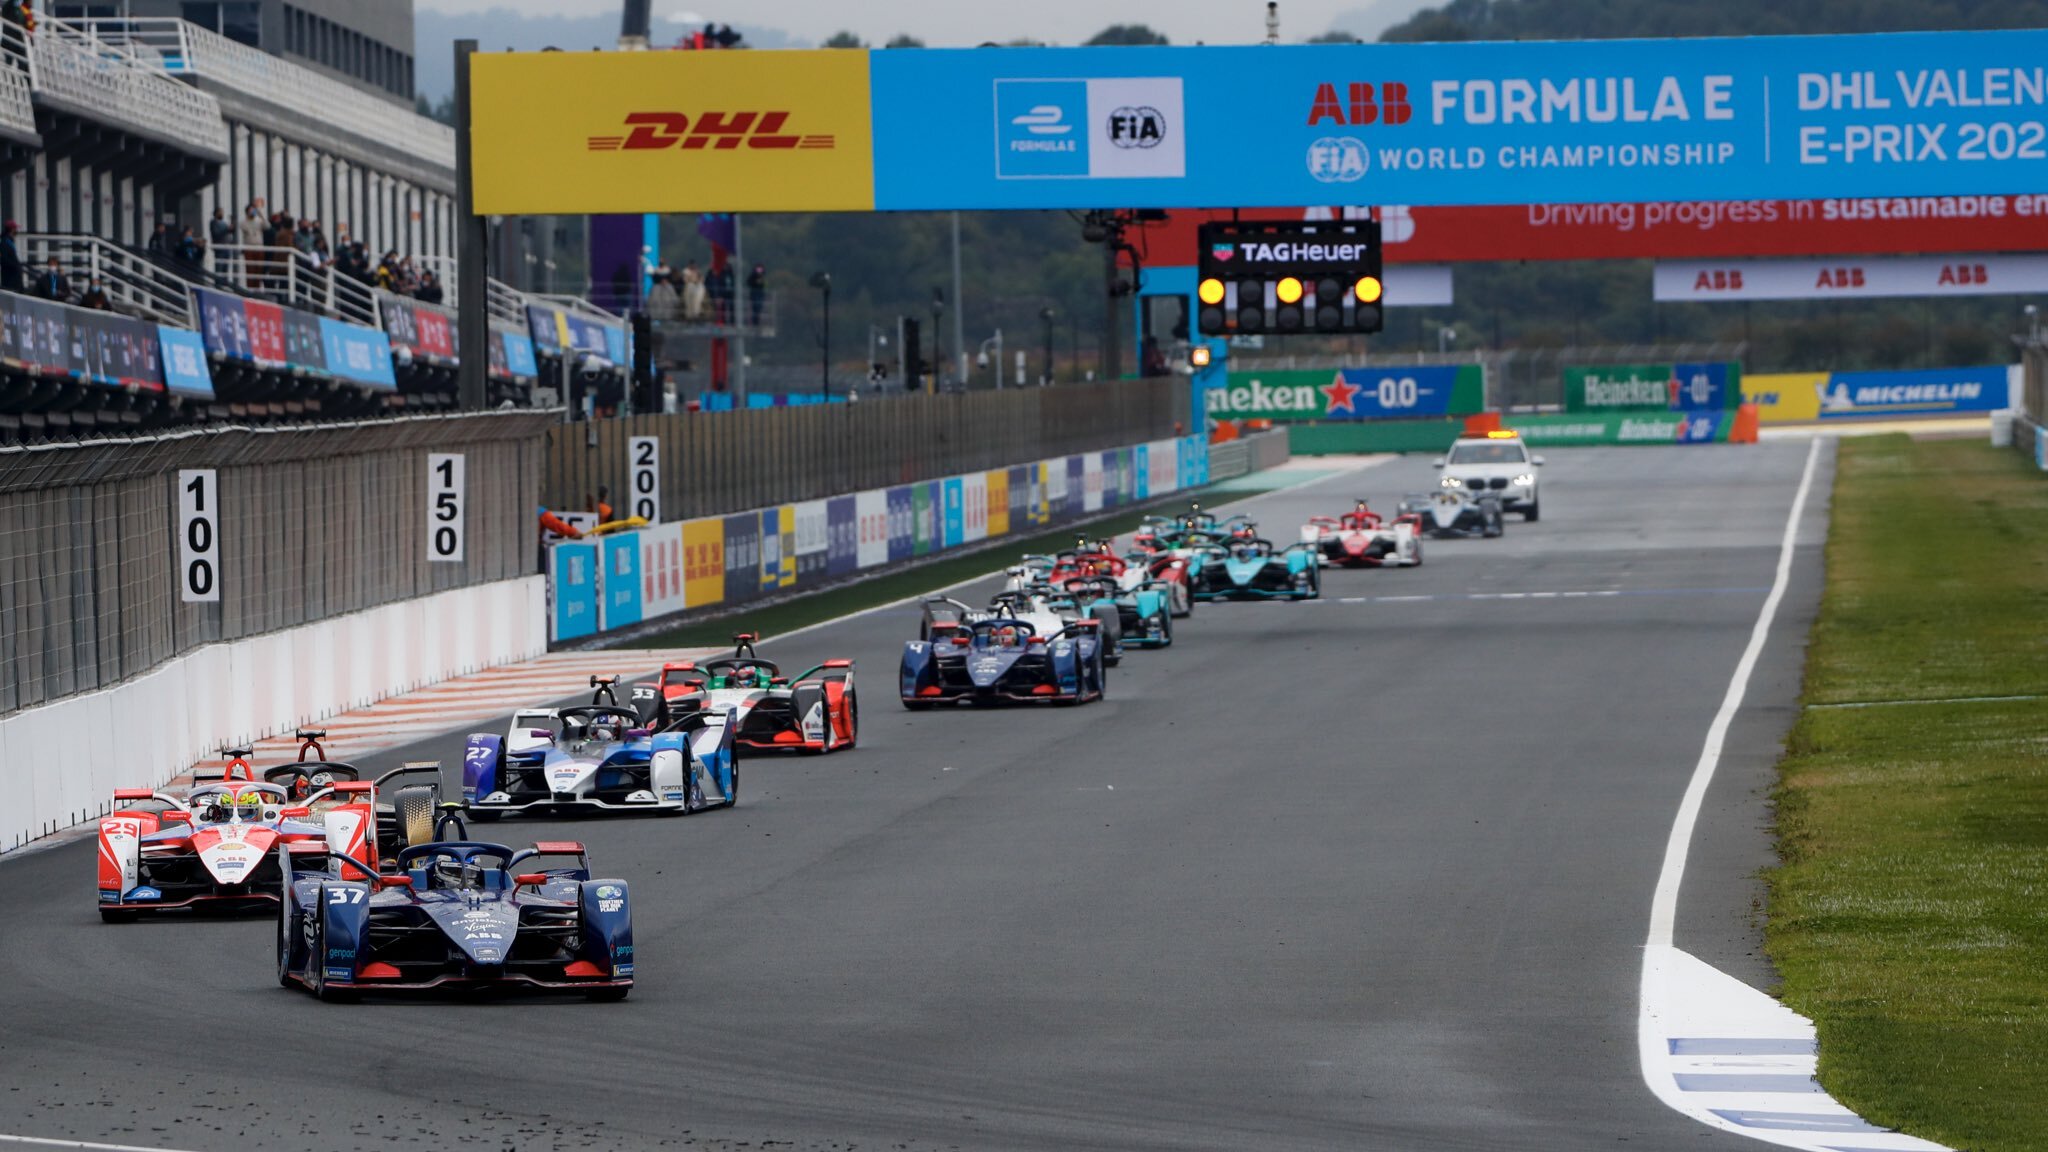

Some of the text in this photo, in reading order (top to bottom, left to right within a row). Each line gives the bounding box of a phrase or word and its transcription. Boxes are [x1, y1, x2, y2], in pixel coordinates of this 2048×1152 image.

[1307, 74, 1735, 126] ABB FORMULA E
[1798, 67, 2048, 111] DHL VALEN
[622, 111, 802, 150] DHL
[1799, 122, 1949, 165] E-PRIX
[1379, 146, 1486, 171] WORLD
[1498, 141, 1736, 169] CHAMPIONSHIP
[1528, 202, 1636, 232] Driving
[1643, 200, 1779, 232] progress
[1788, 199, 1815, 221] in
[1822, 195, 2008, 222] sustainable
[1693, 270, 1744, 292] ABB
[1815, 268, 1866, 290] ABB
[1937, 265, 1989, 287] ABB
[1206, 378, 1318, 412] neken
[1856, 381, 1983, 405] MICHELIN
[636, 440, 655, 522] 200
[434, 458, 458, 556] 150
[186, 474, 214, 596] 100
[909, 643, 923, 654] 4
[631, 687, 656, 700] 33
[465, 746, 493, 762] 27
[104, 821, 138, 839] 29
[327, 887, 366, 905] 37
[464, 932, 503, 940] ABB
